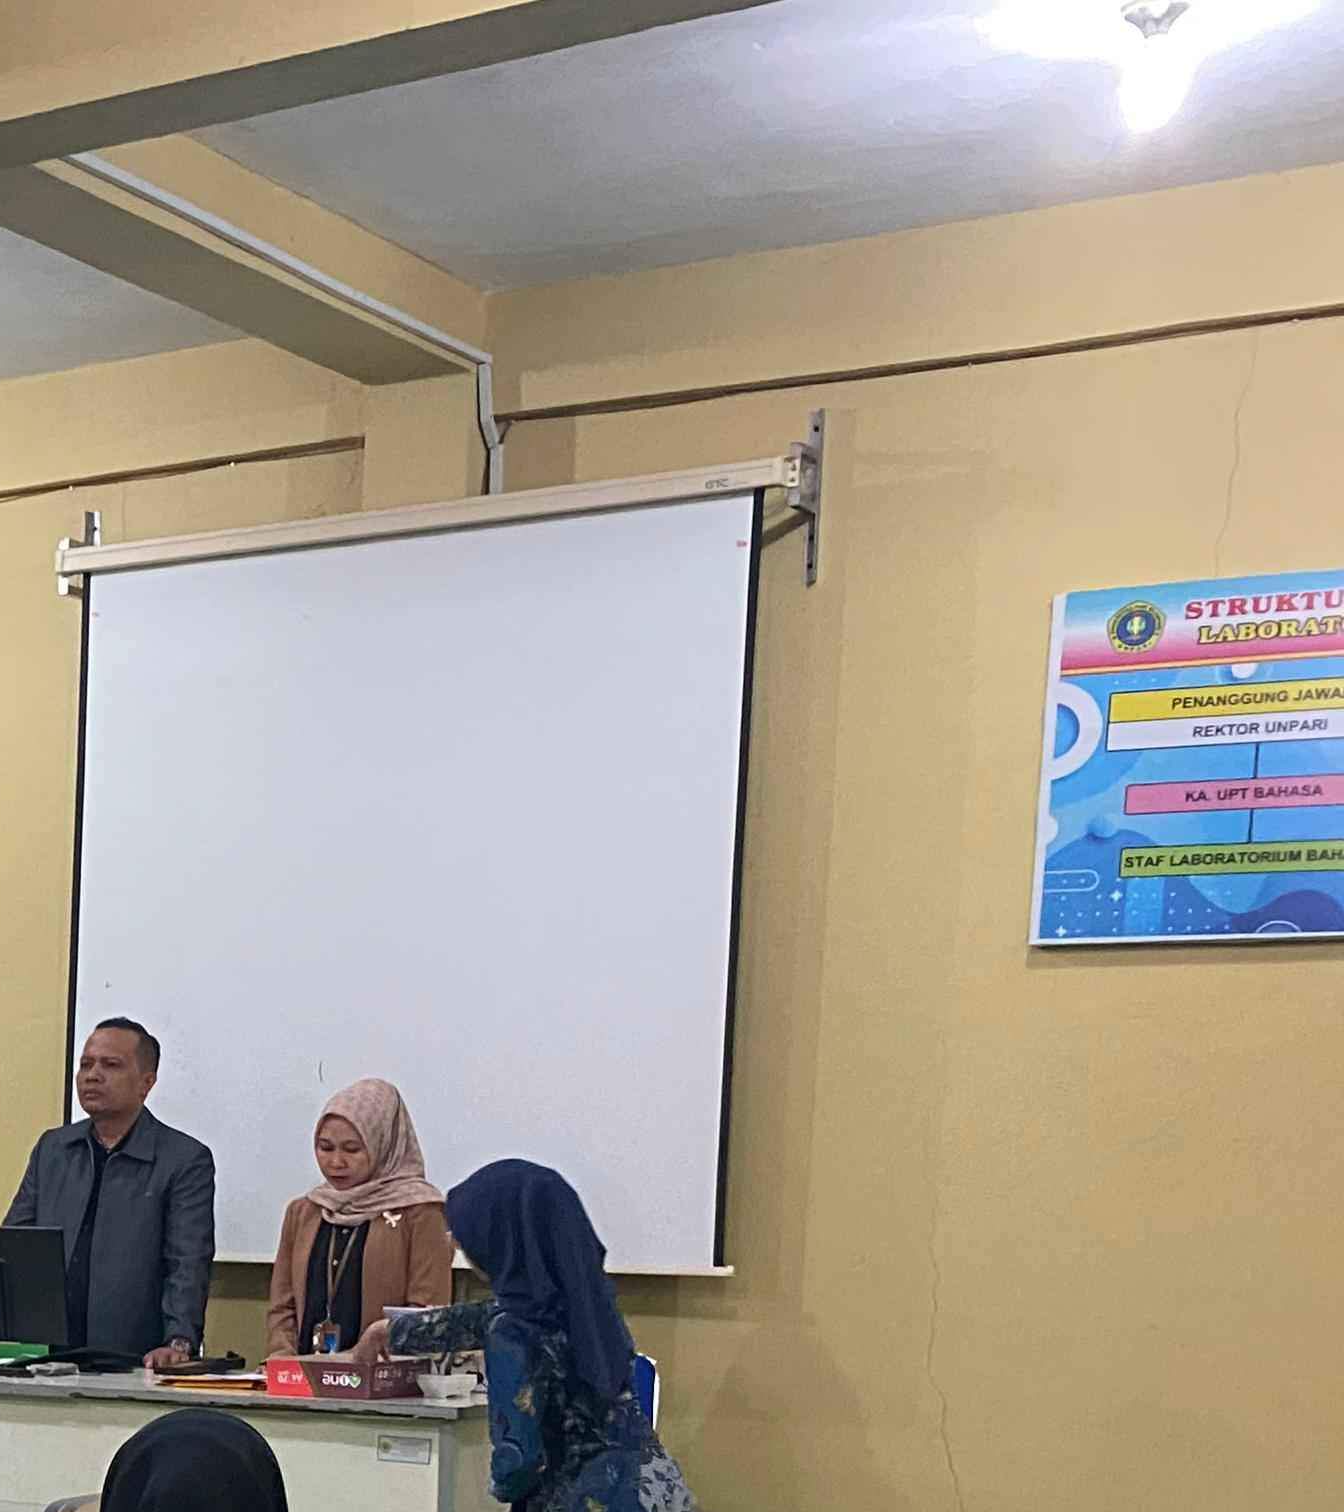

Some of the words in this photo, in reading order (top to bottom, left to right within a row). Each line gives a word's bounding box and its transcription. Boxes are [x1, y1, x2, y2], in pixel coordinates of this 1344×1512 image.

[1197, 615, 1344, 644] LABORAT
[1172, 690, 1288, 711] PENANGGUNG
[1192, 722, 1259, 738] REKTOR
[1265, 718, 1328, 734] UNPARI
[1217, 787, 1249, 801] UPT
[1253, 784, 1323, 799] BAHASA
[1124, 854, 1165, 868] STAF
[1170, 849, 1302, 867] LABORATORIUM
